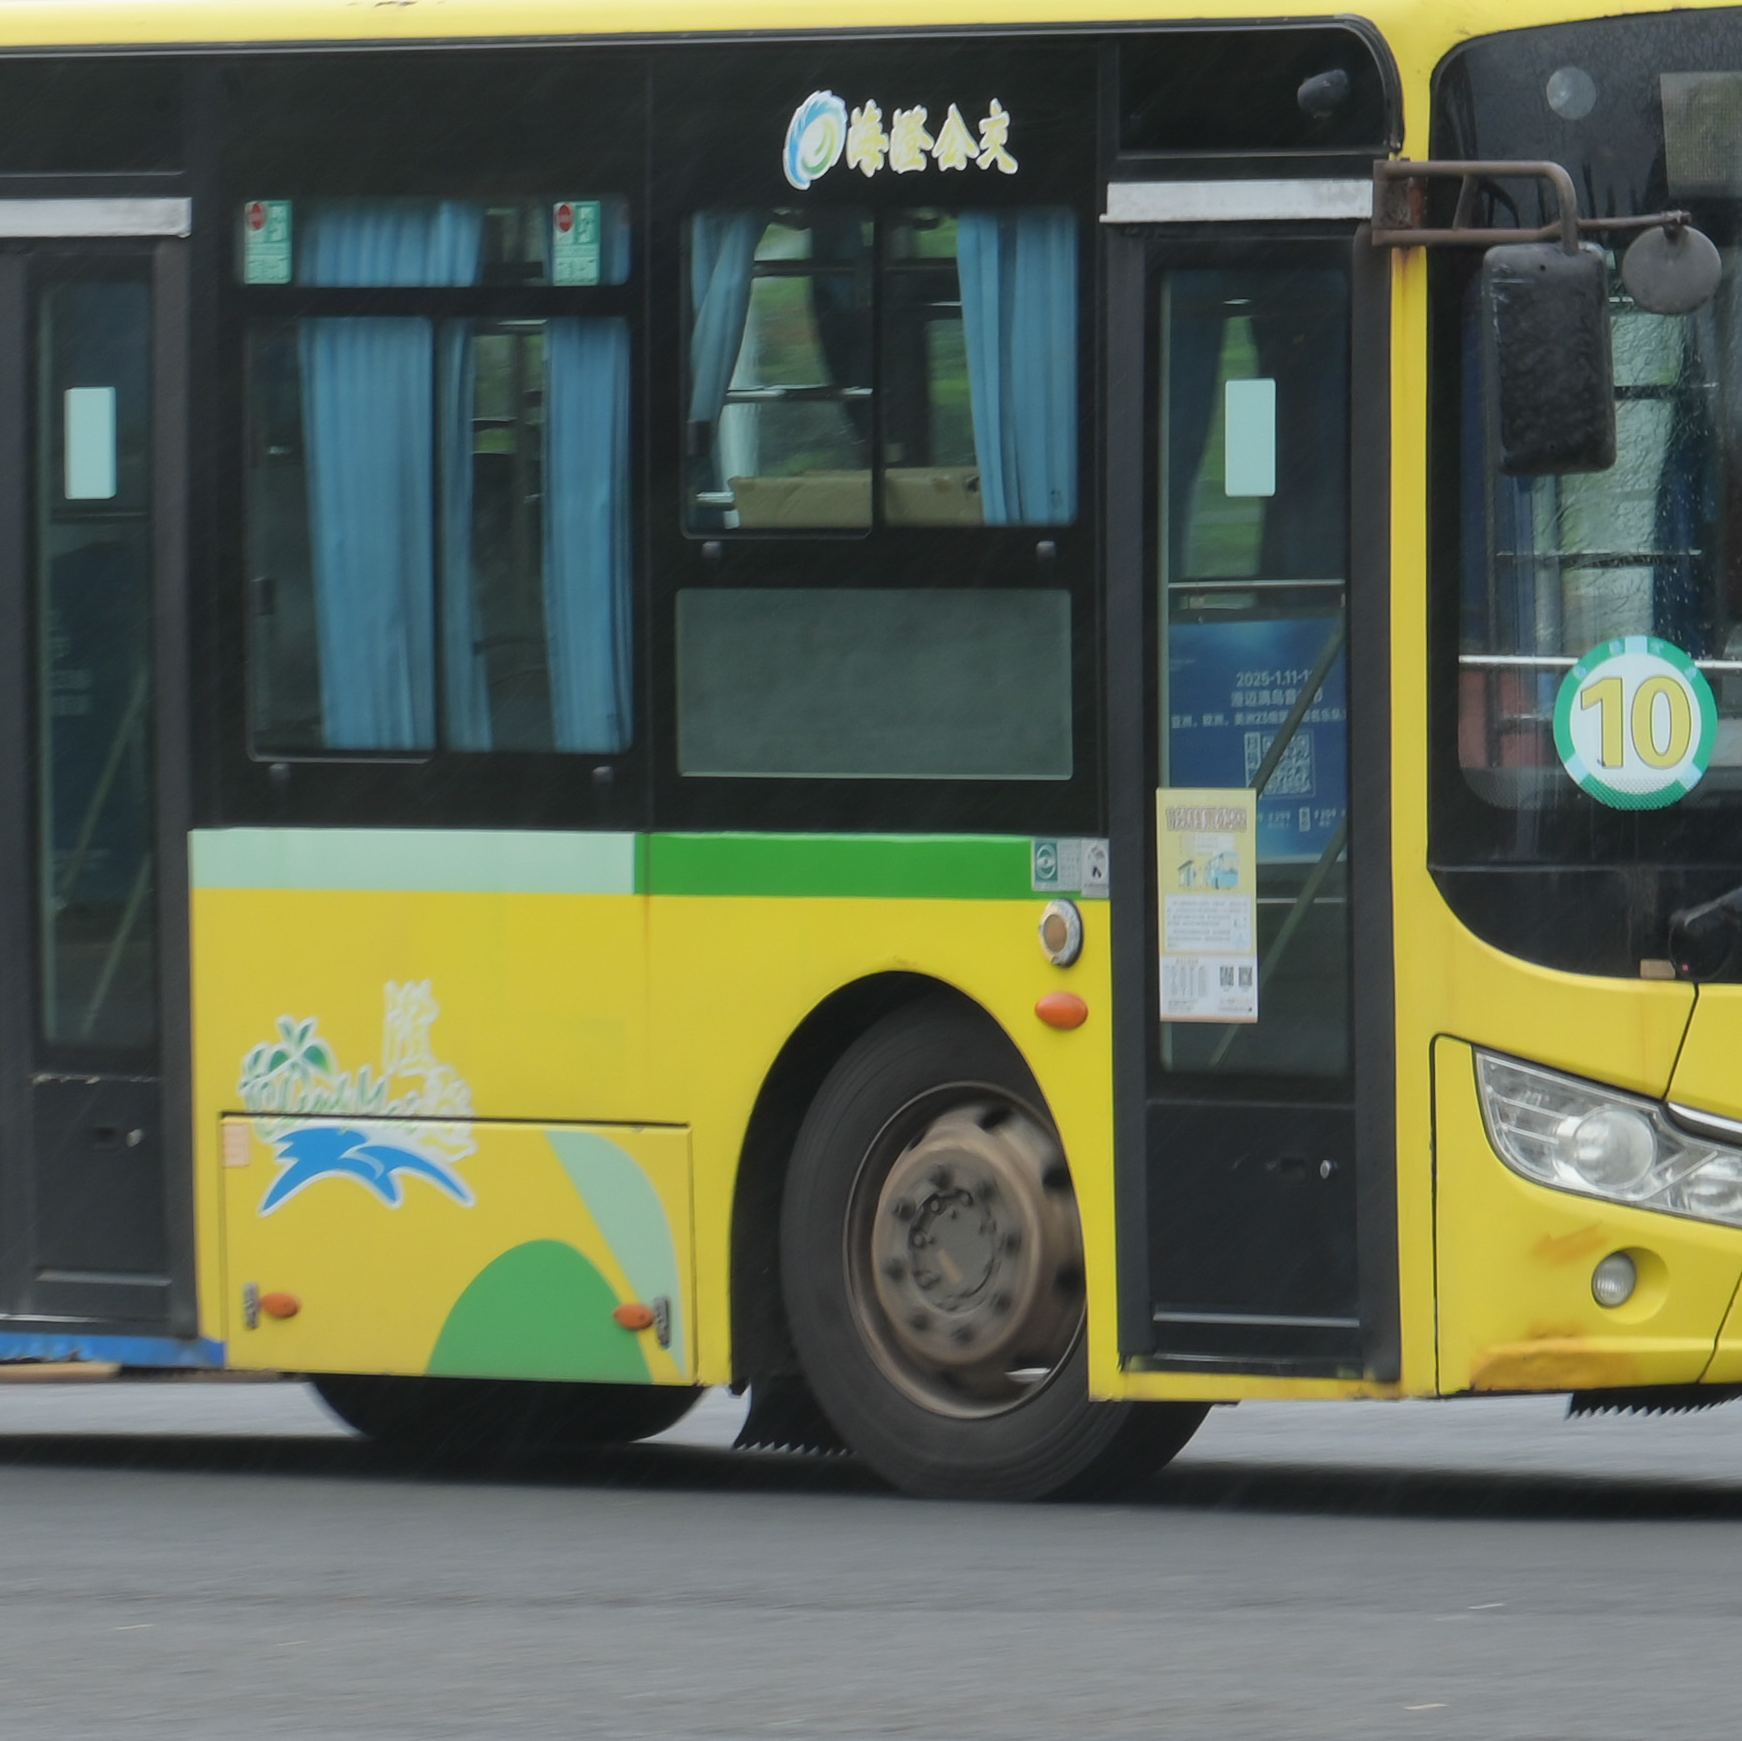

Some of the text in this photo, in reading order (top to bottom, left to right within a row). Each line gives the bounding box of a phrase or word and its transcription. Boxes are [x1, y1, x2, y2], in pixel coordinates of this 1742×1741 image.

[846, 97, 1018, 178] 海澄公交
[1580, 676, 1692, 769] 10
